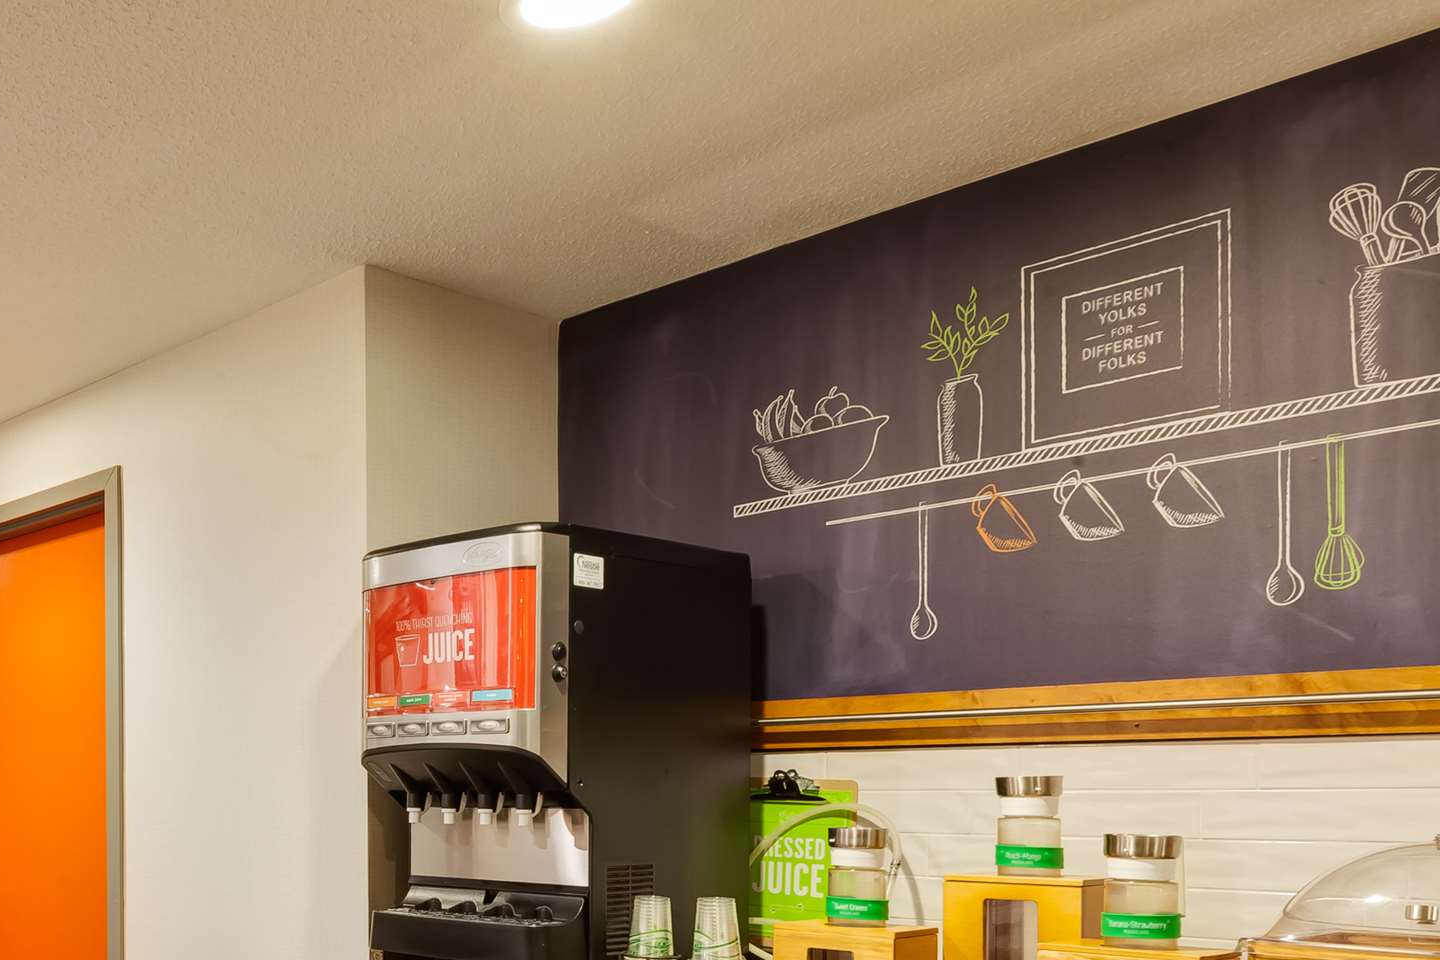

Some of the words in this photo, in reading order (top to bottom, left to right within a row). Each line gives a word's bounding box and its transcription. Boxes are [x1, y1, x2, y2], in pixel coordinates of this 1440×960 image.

[1081, 282, 1164, 315] DIFFERENT
[1098, 302, 1147, 325] YOLKS
[1110, 324, 1133, 338] FOR
[1081, 331, 1164, 361] DIFFERENT
[1098, 351, 1147, 374] FOLKS
[422, 628, 475, 664] JUICE
[753, 834, 826, 861] ESSED
[752, 861, 825, 898] JUICE
